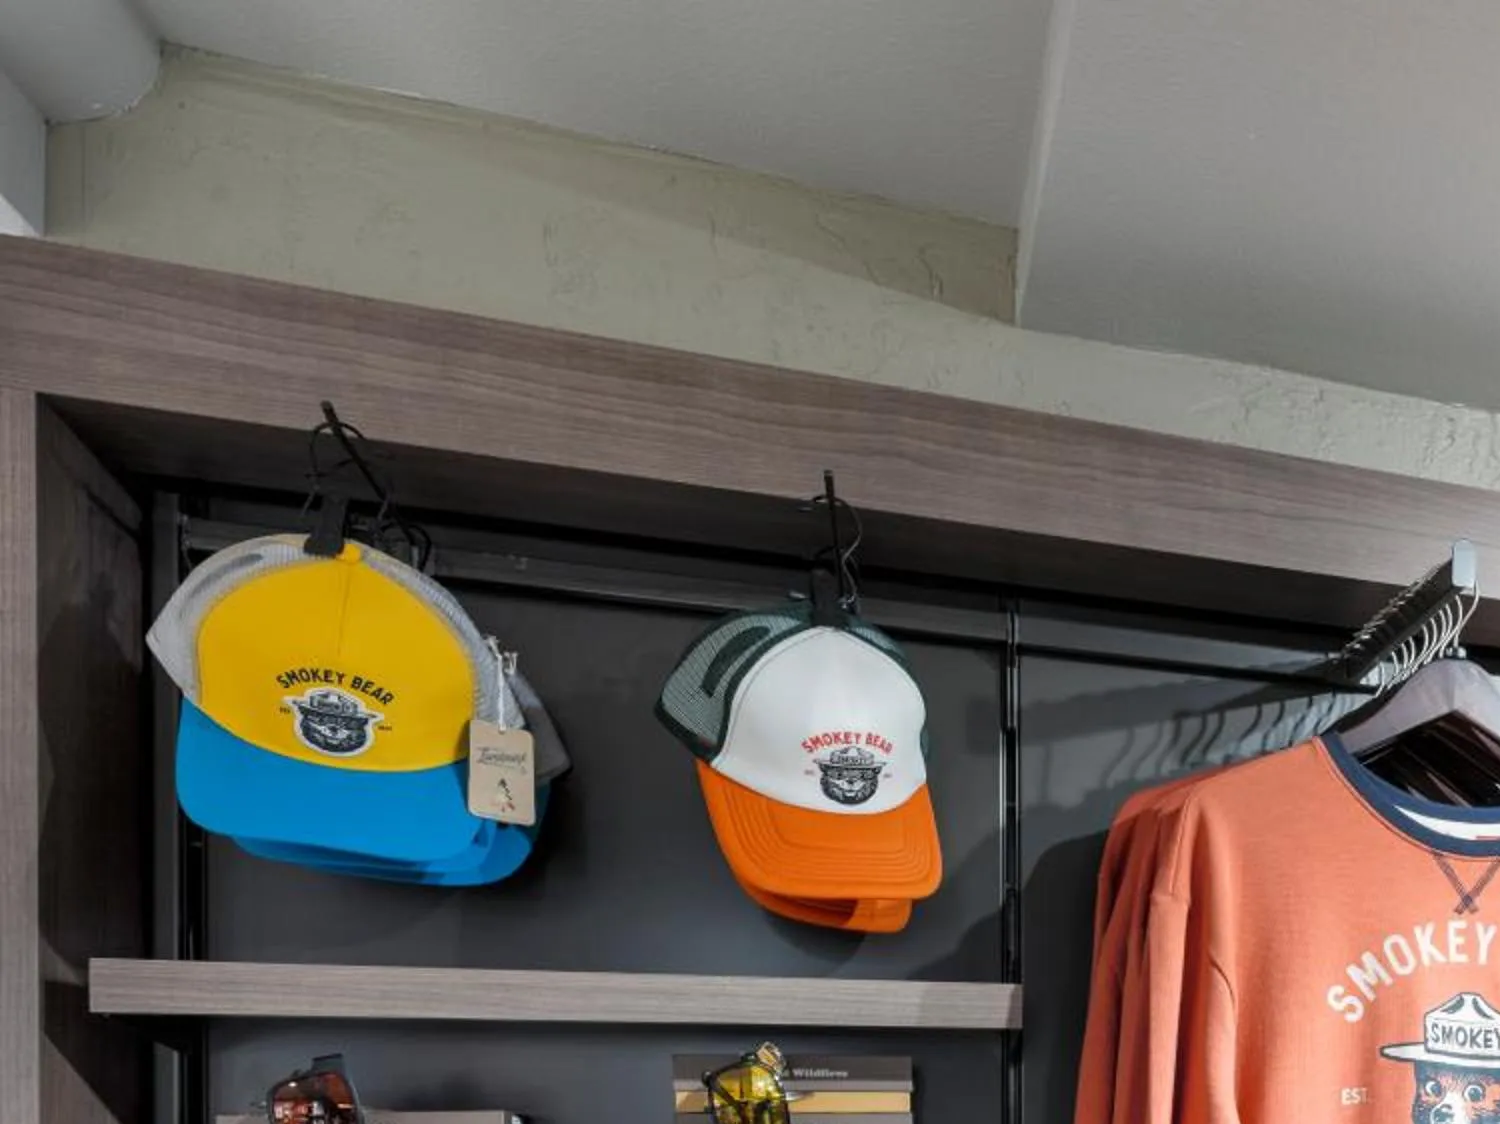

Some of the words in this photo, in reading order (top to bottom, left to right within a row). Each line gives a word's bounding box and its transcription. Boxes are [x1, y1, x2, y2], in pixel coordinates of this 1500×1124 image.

[276, 668, 345, 688] SMOKEY
[351, 676, 395, 705] BEAR
[801, 731, 862, 753] SMOKEY
[865, 732, 893, 755] BEAR
[1327, 920, 1497, 1023] SMOKEY
